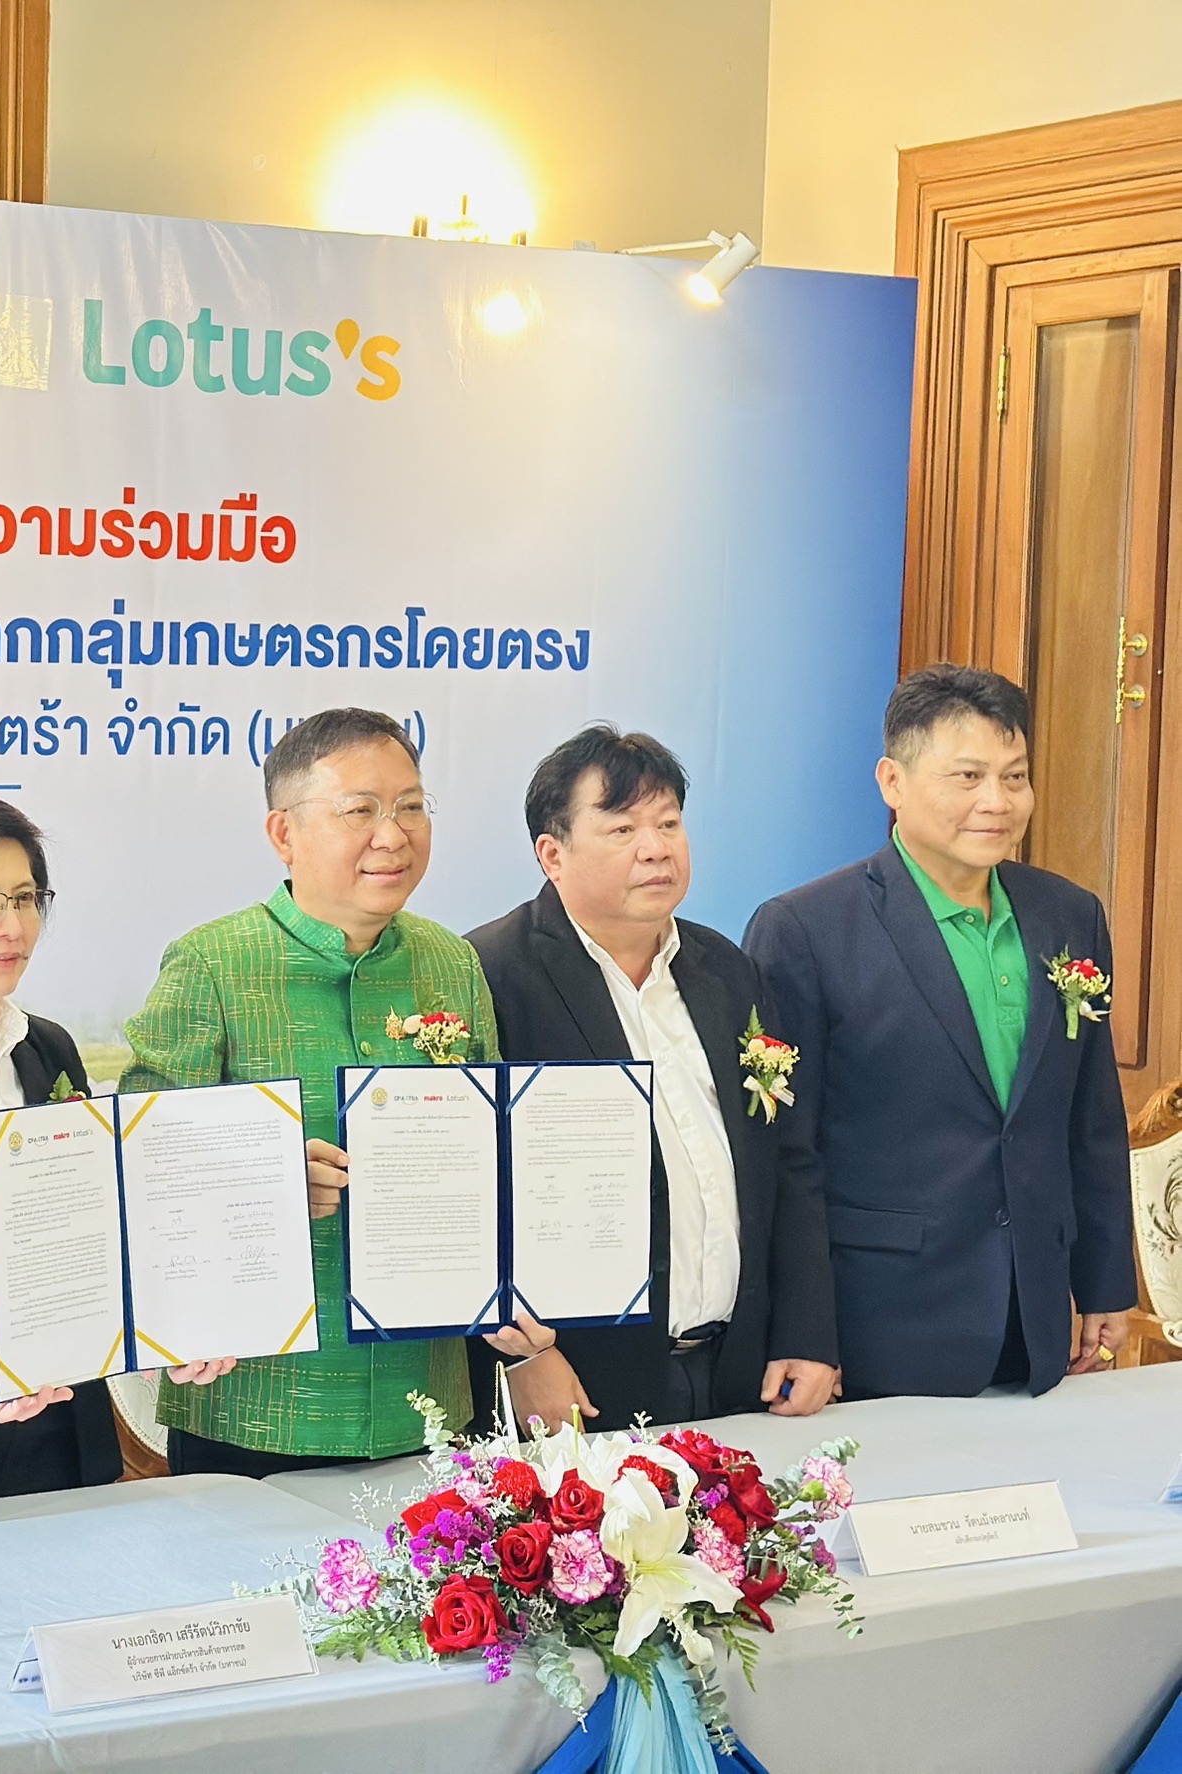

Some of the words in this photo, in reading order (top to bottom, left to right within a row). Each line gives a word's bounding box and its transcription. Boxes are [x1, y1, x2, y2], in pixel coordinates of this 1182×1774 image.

[83, 298, 403, 402] Lotus's
[107, 697, 231, 756] จำกัด
[111, 1628, 173, 1650] นางเอกธิดา
